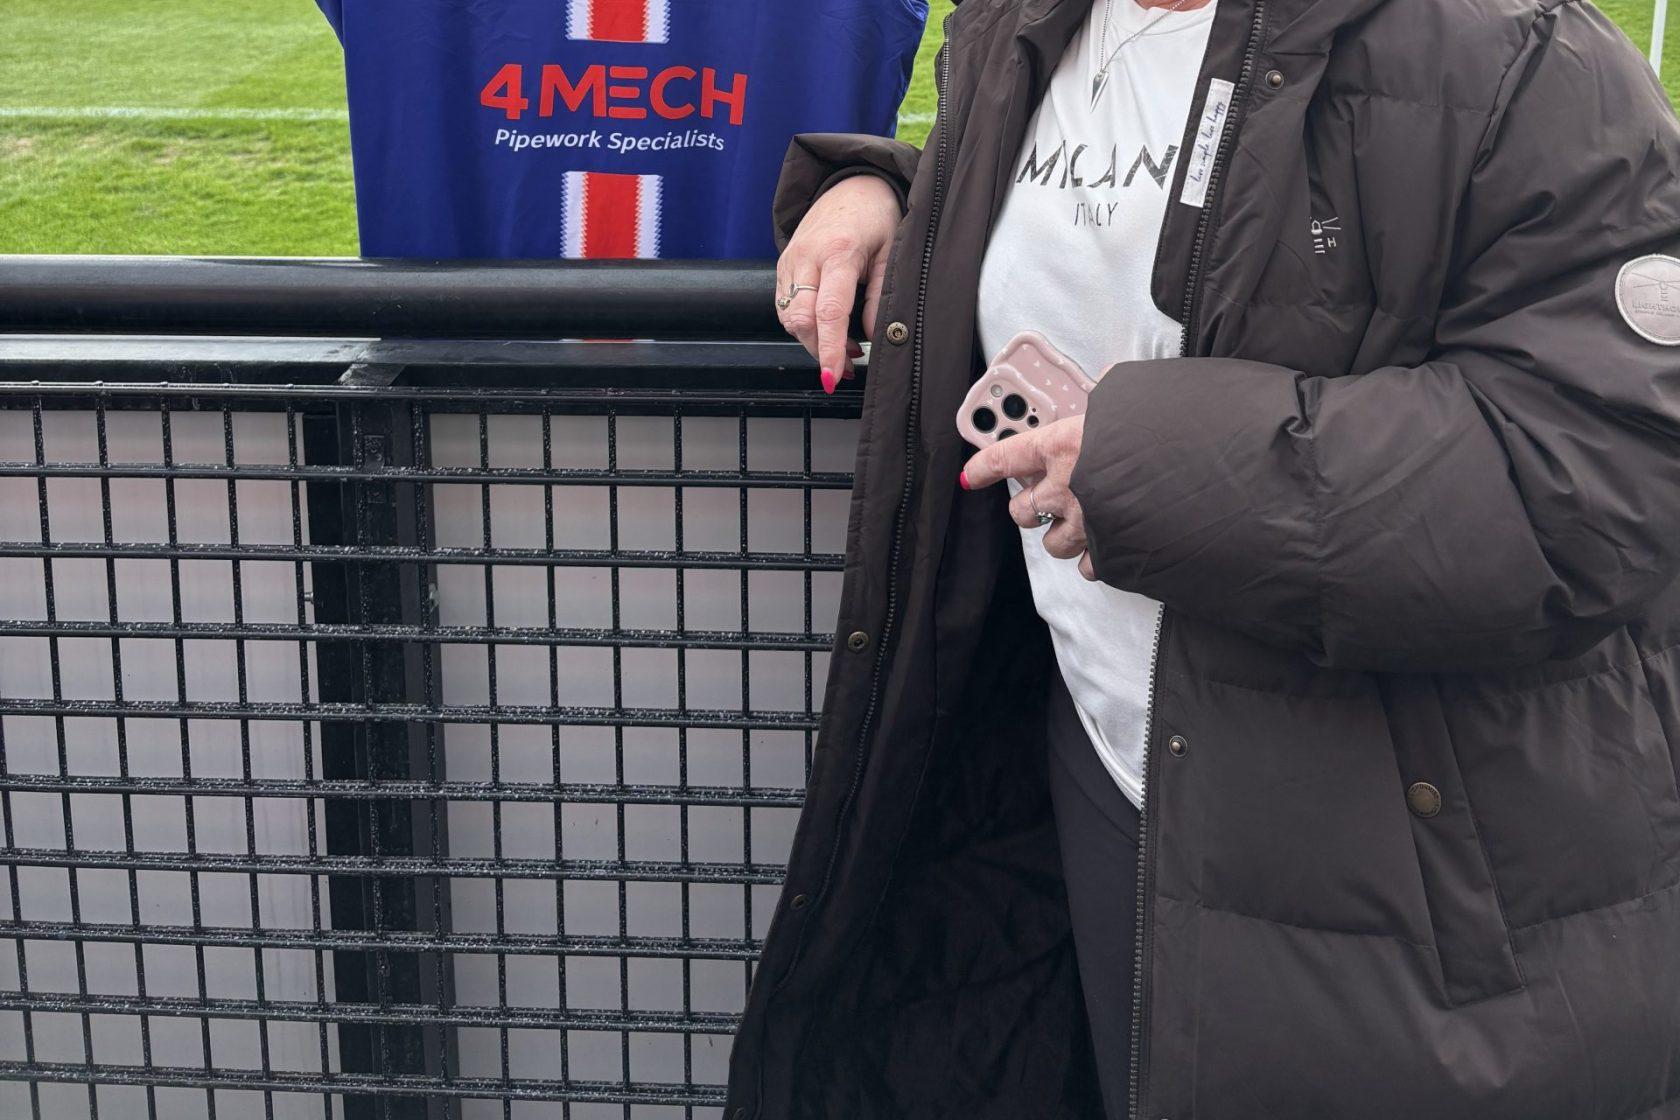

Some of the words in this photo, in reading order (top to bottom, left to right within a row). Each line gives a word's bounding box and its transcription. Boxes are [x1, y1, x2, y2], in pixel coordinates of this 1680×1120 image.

[480, 64, 748, 126] 4MECH
[494, 128, 602, 152] Pipework
[606, 130, 725, 154] Specialists
[1074, 201, 1119, 227] ITALY
